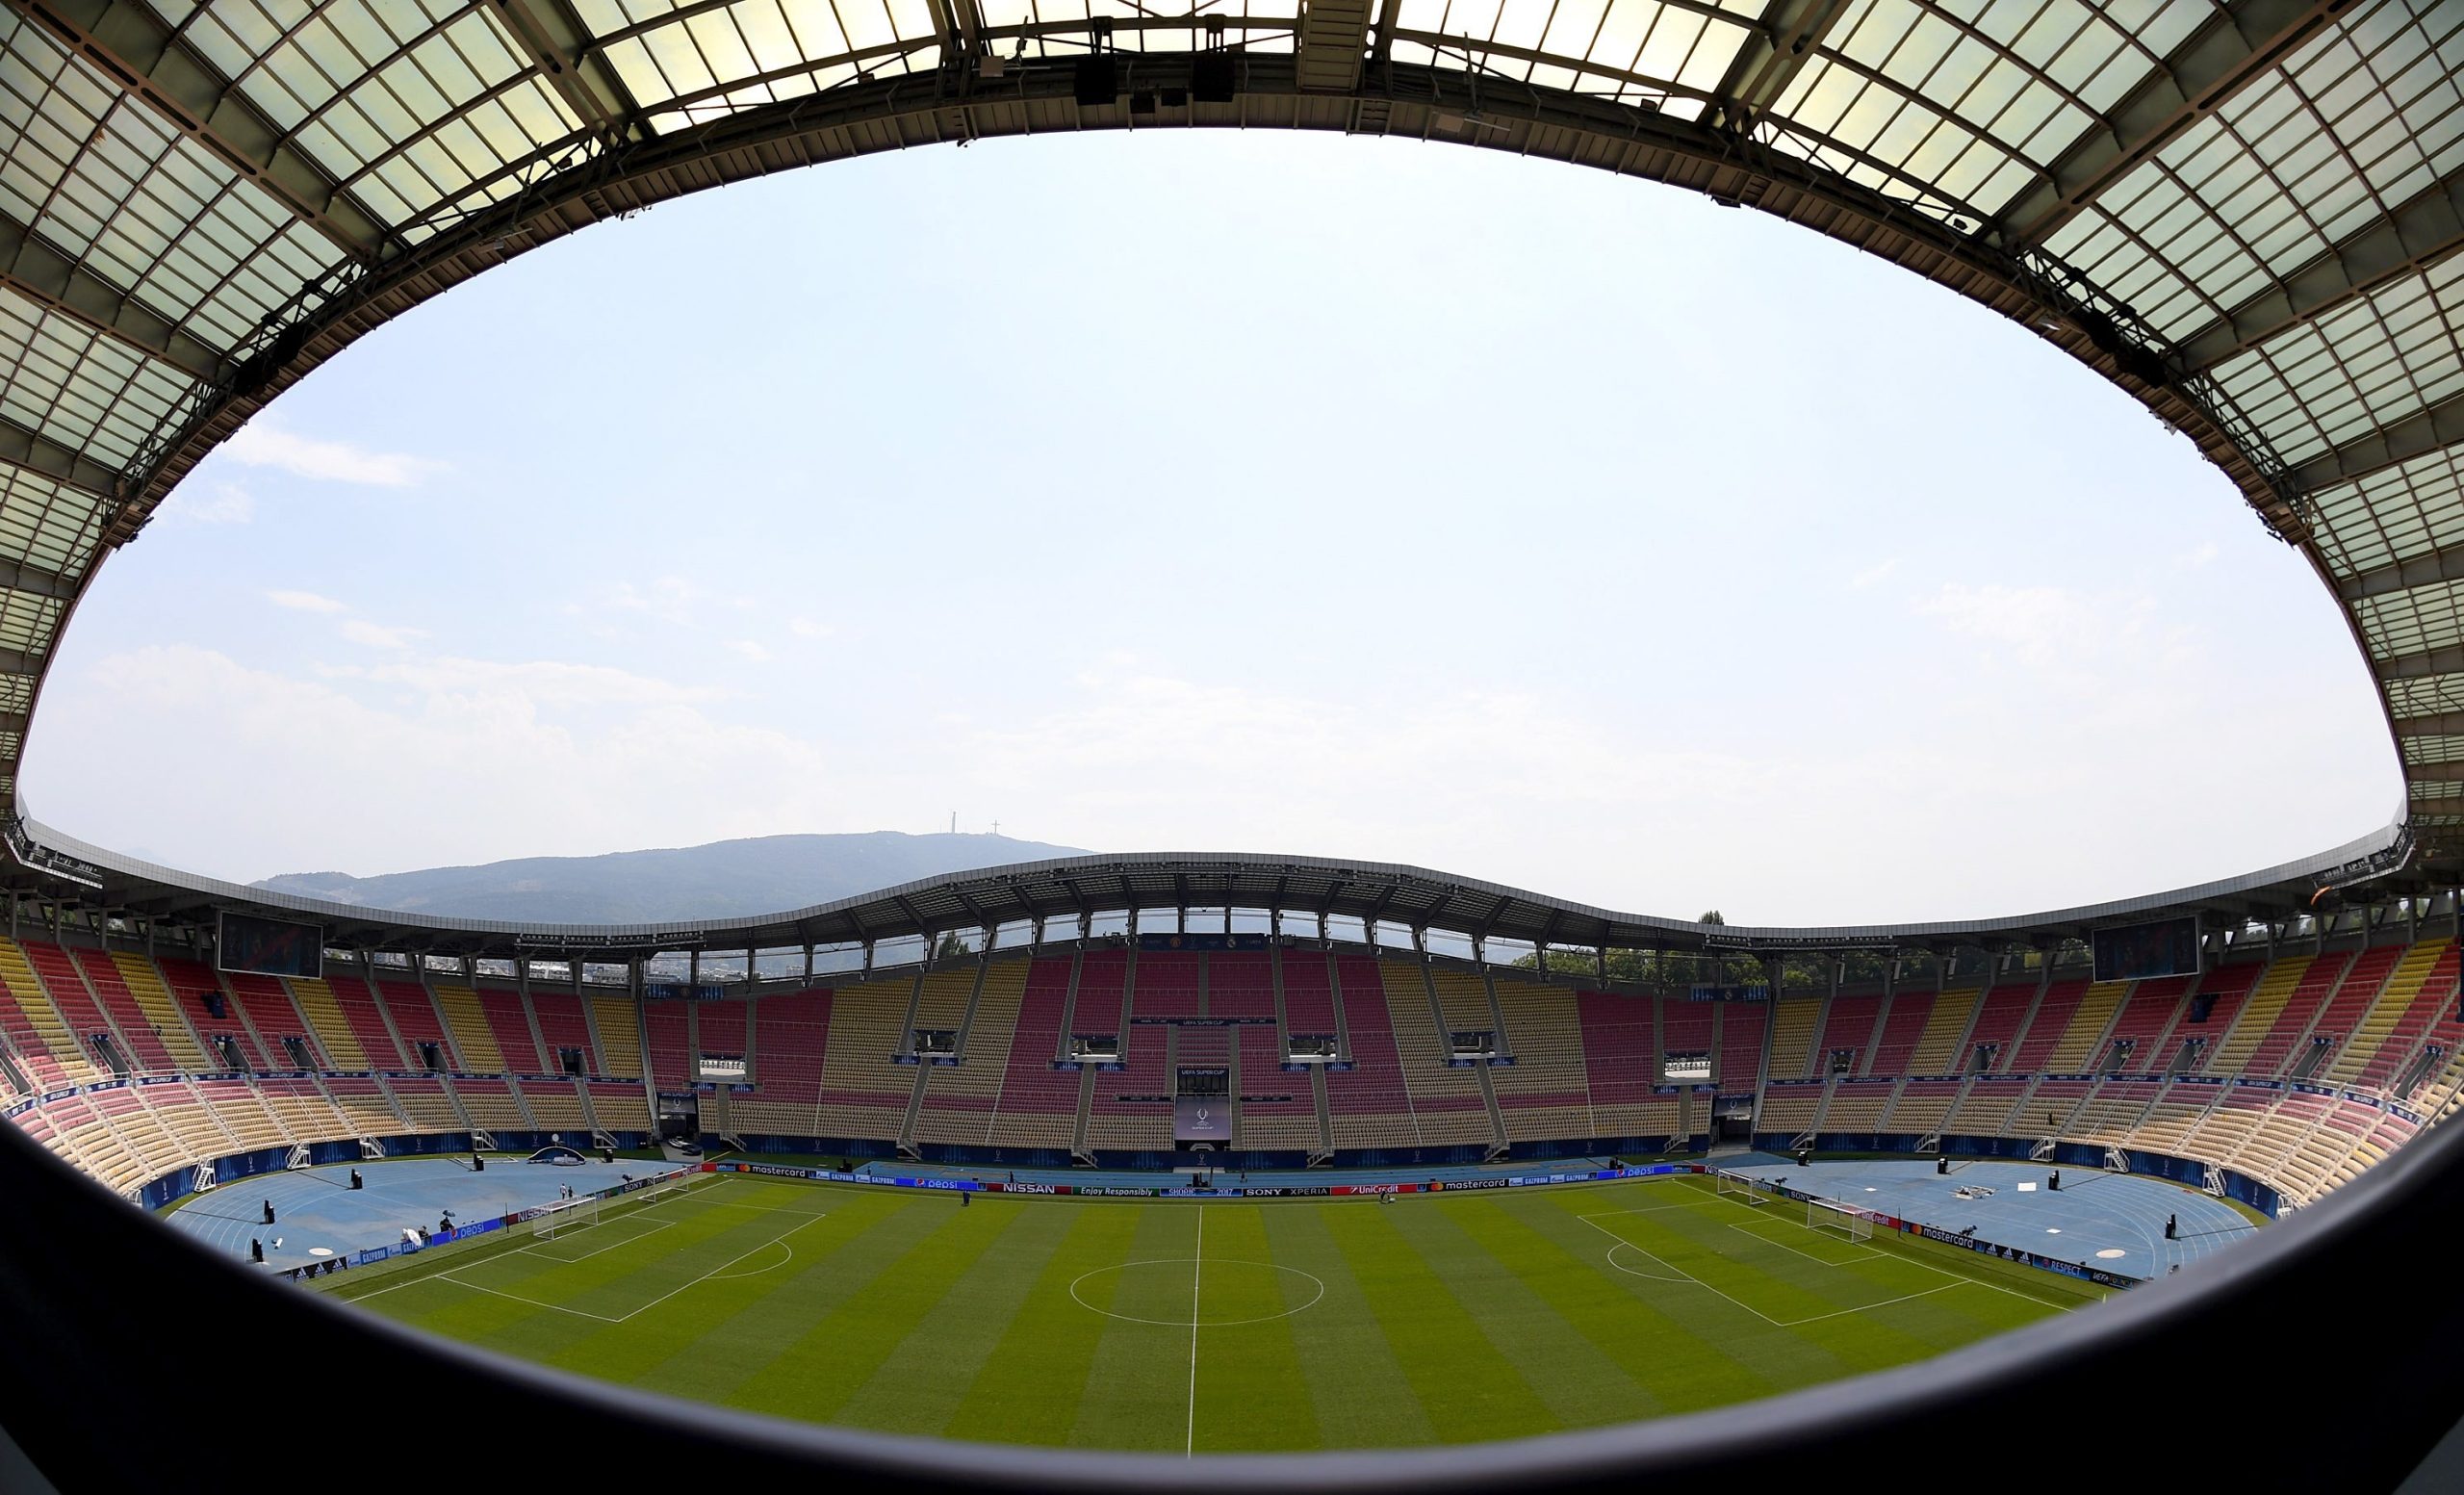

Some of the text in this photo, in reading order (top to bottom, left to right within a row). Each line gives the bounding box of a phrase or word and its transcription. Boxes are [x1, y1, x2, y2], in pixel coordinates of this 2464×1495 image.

[752, 1165, 806, 1178] mastercard
[1628, 1166, 1655, 1176] pepsi
[624, 1181, 643, 1193] SONY
[928, 1179, 958, 1190] pepsi
[1003, 1182, 1056, 1194] NISSAN
[1359, 1184, 1399, 1194] UniCredit
[1446, 1178, 1505, 1190] mastercard
[1080, 1187, 1153, 1197] Enjoy Responsibly
[1217, 1188, 1233, 1197] 2017
[1290, 1187, 1328, 1196] XPERIA
[1790, 1191, 1812, 1202] SONY
[517, 1207, 552, 1223] NISSAN
[460, 1224, 485, 1240] pepsi
[1923, 1227, 1974, 1249] mastercard
[362, 1249, 386, 1263] GAZPROM
[2051, 1260, 2082, 1276] RESPECT
[2092, 1272, 2109, 1282] UEFA
